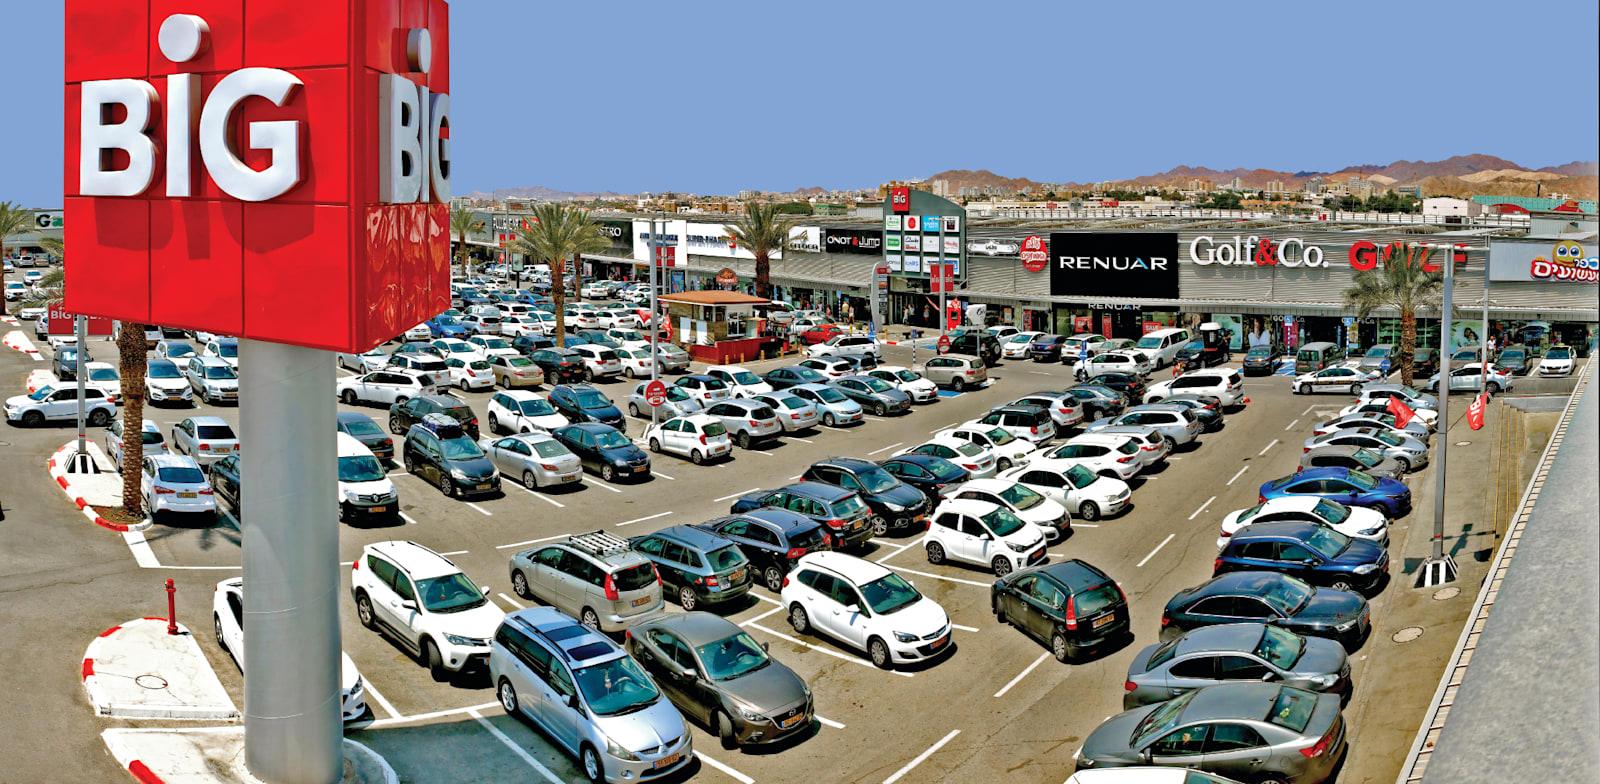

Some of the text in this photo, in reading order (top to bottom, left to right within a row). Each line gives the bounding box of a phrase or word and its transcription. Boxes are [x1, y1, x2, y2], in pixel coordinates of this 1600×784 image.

[1189, 235, 1329, 268] Golf&Co.
[1059, 255, 1168, 271] RENUAR
[1088, 302, 1142, 310] RENUAR
